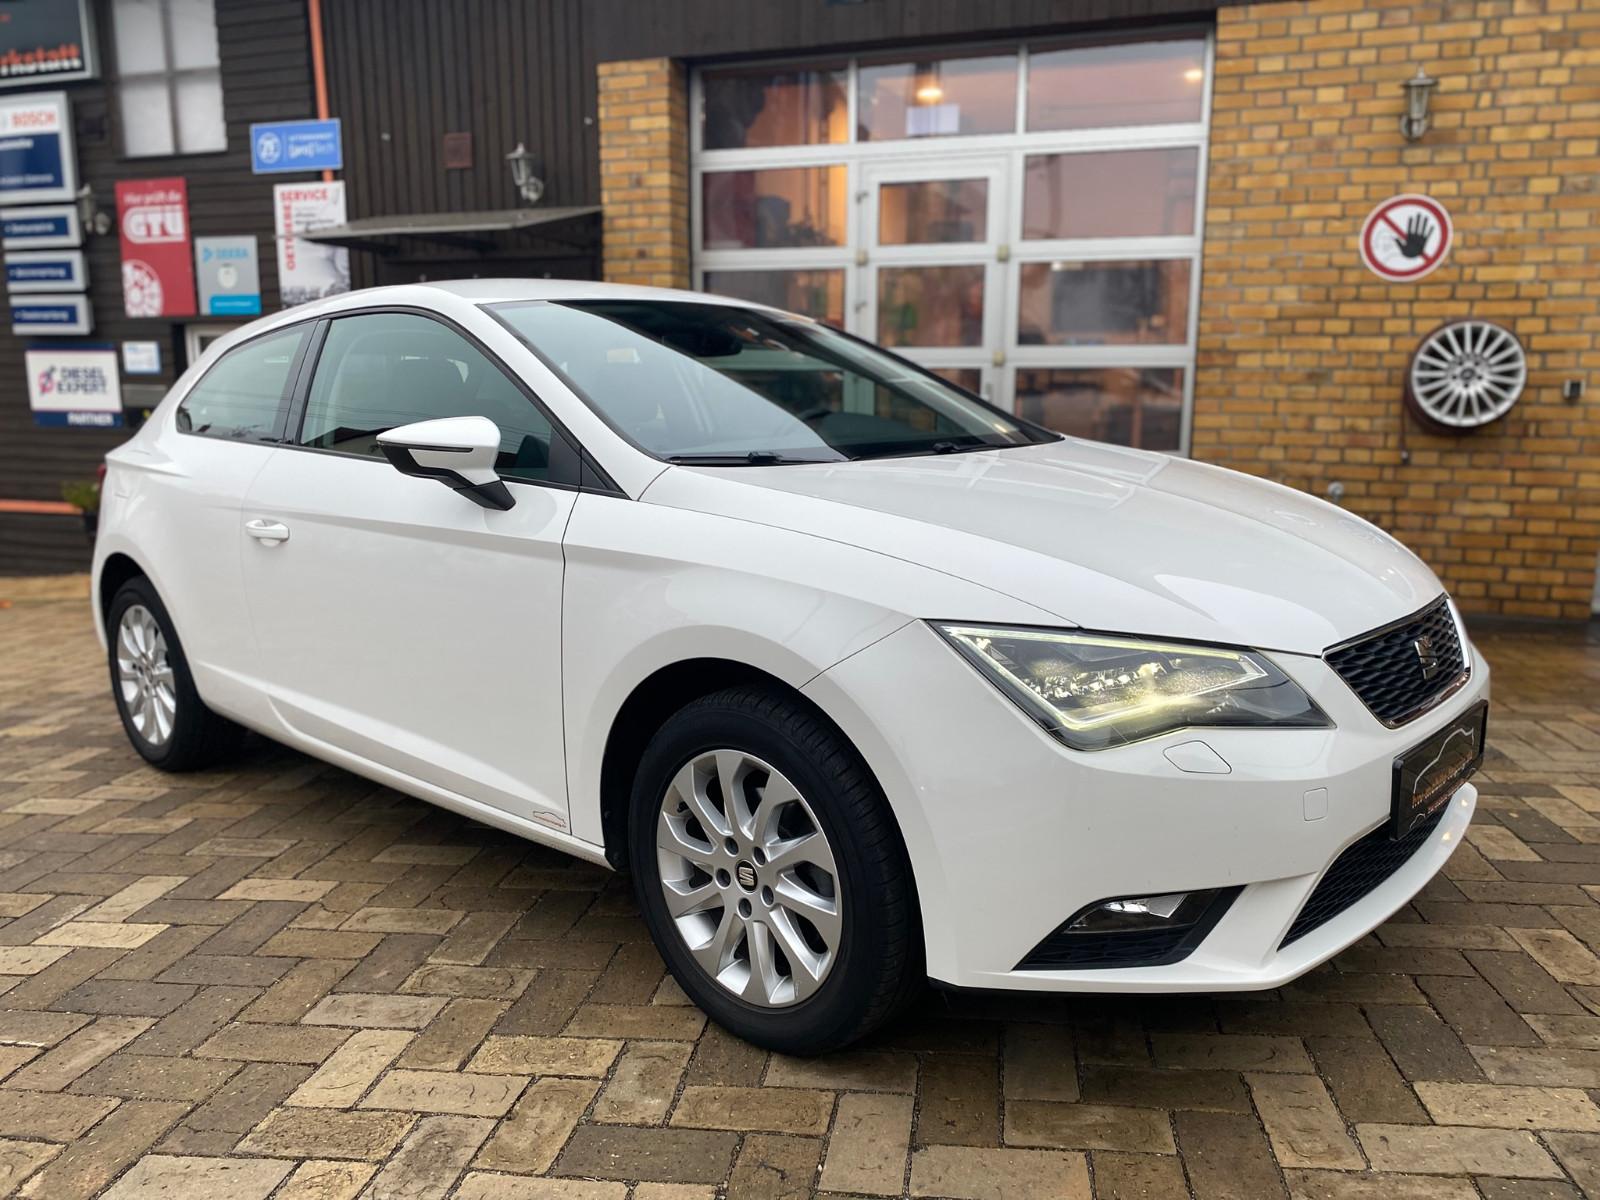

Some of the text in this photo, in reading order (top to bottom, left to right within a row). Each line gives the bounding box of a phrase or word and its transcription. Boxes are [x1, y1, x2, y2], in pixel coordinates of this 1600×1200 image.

[11, 110, 57, 127] BOSCH
[280, 189, 329, 201] SERVICE
[60, 366, 105, 380] DIESEL
[57, 380, 107, 395] EXPERT
[67, 411, 114, 426] PARTNER
